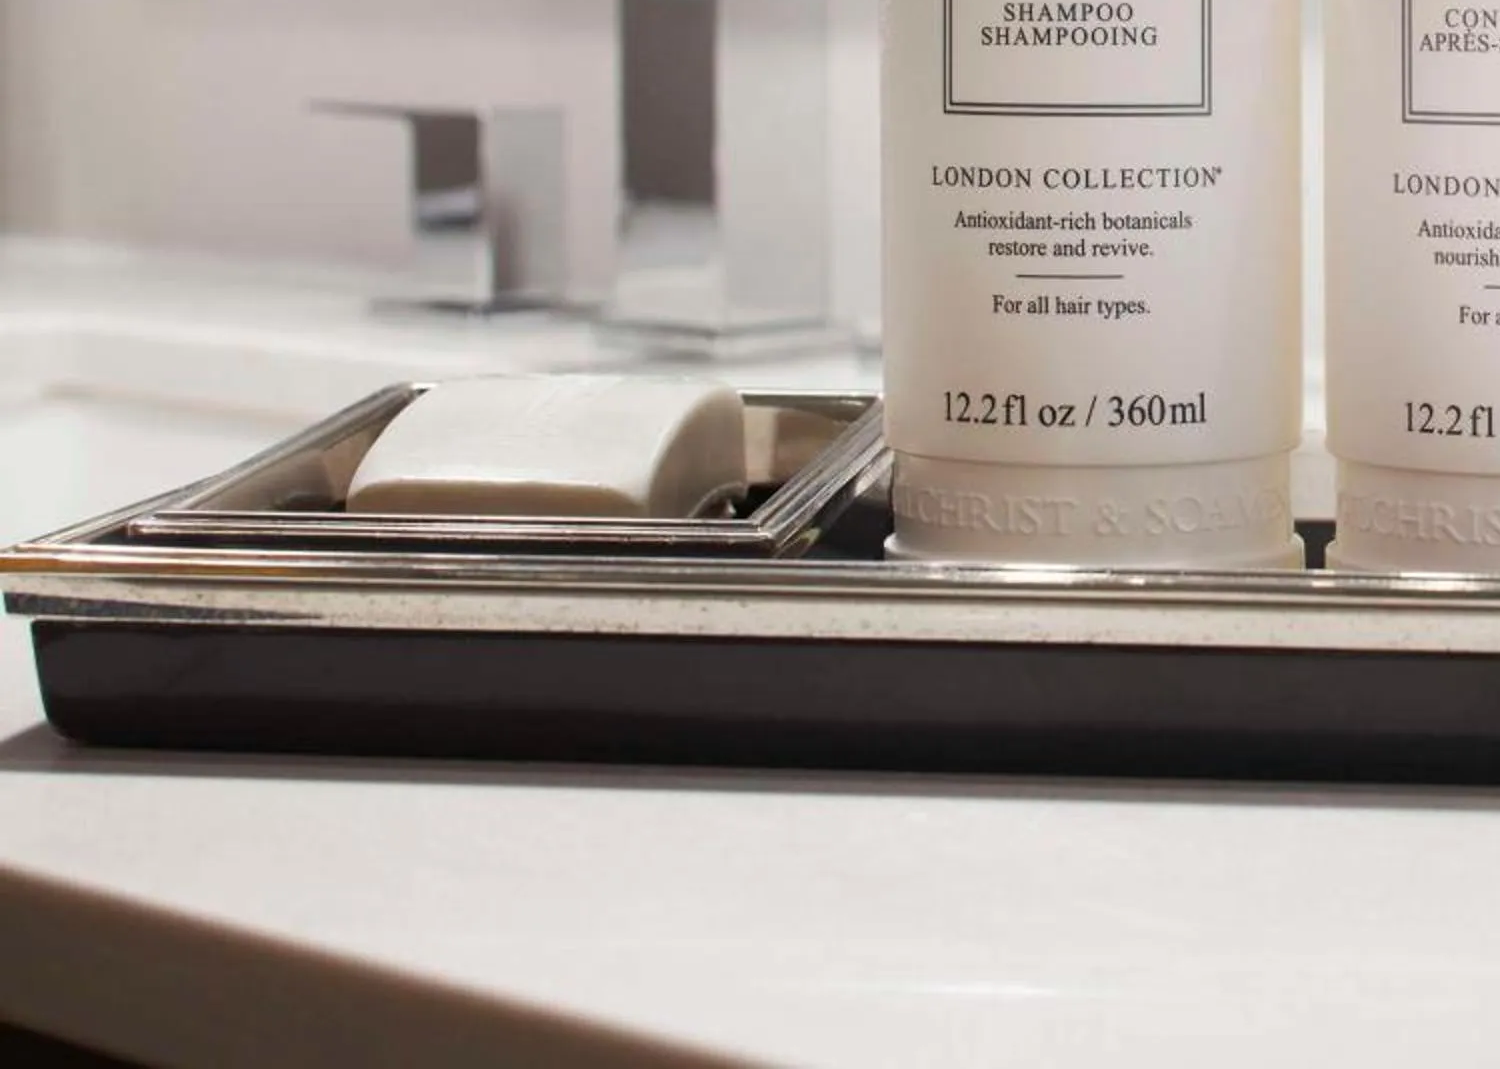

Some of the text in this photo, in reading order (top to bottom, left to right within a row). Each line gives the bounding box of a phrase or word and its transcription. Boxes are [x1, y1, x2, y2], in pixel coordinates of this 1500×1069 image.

[1004, 3, 1133, 22] SHAMPOO
[981, 26, 1157, 46] SHAMPOOING
[932, 166, 1031, 188] LONDON
[1394, 173, 1500, 197] LONDON
[954, 211, 1192, 231] Antioxidant-rich botanicals
[988, 238, 1153, 257] restore and revive.
[1434, 247, 1500, 268] nourish
[992, 295, 1150, 319] For all hair types.
[1460, 305, 1491, 325] For
[1038, 405, 1075, 427] oz
[1085, 395, 1097, 427] /
